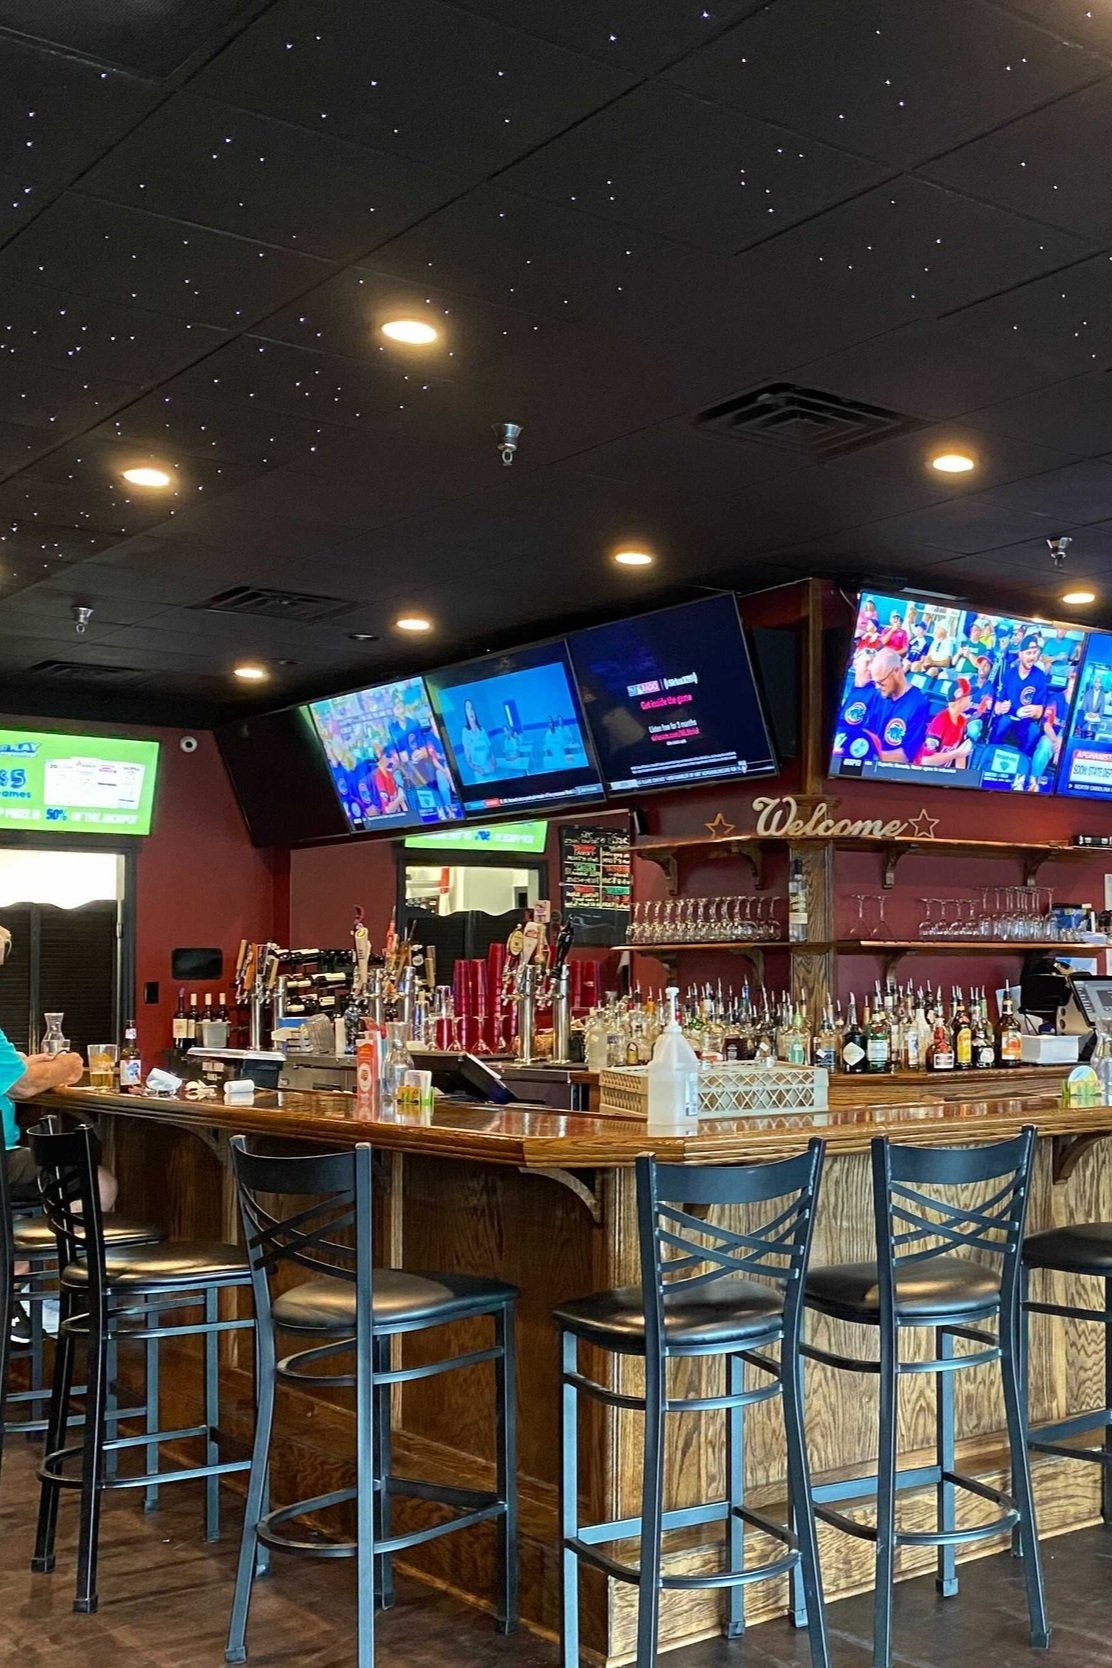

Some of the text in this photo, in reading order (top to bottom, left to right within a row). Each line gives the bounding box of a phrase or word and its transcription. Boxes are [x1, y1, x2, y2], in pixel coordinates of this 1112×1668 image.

[0, 790, 31, 798] ames
[46, 808, 67, 820] 50%
[753, 797, 908, 837] Welcome
